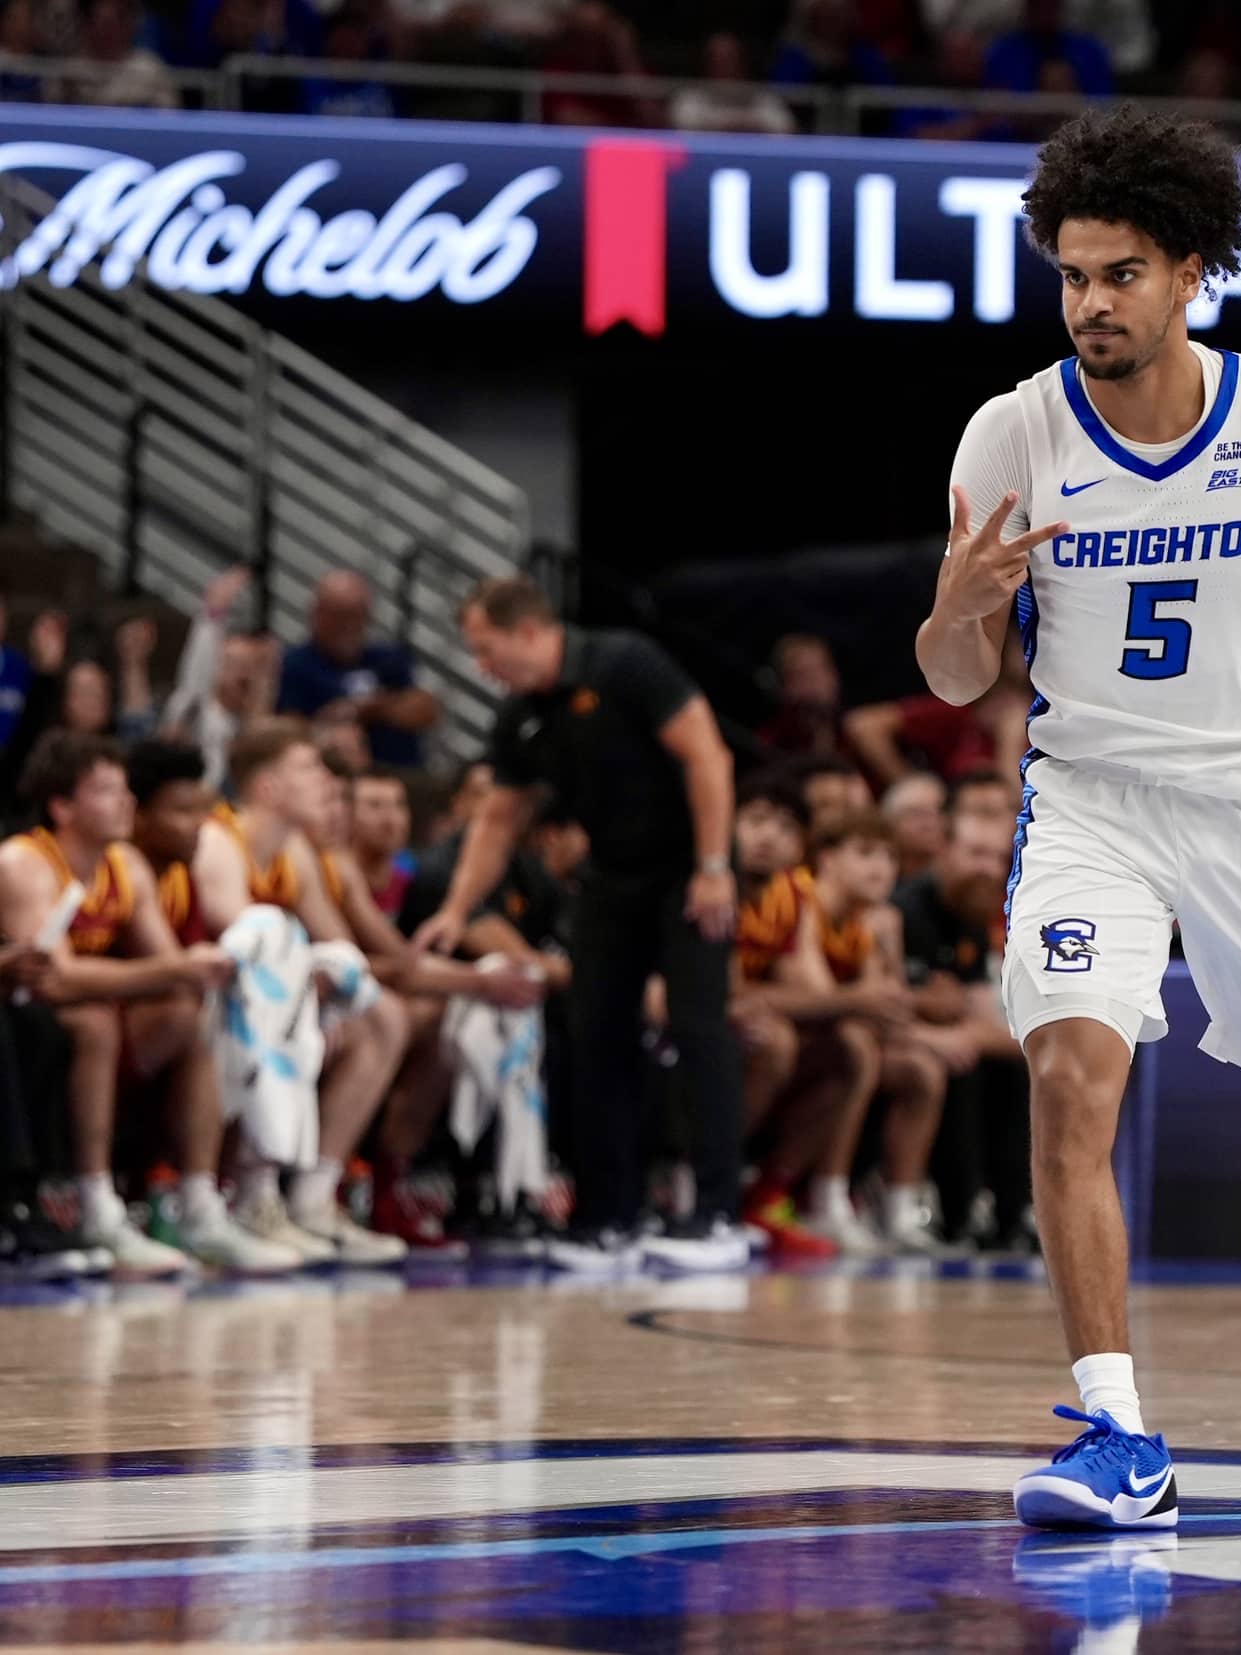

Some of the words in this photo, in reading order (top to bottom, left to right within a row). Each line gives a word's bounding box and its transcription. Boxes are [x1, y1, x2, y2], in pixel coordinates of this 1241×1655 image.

[0, 141, 563, 303] Michelob
[1211, 468, 1239, 479] BIG
[1217, 442, 1229, 452] BE
[1117, 579, 1199, 680] 5
